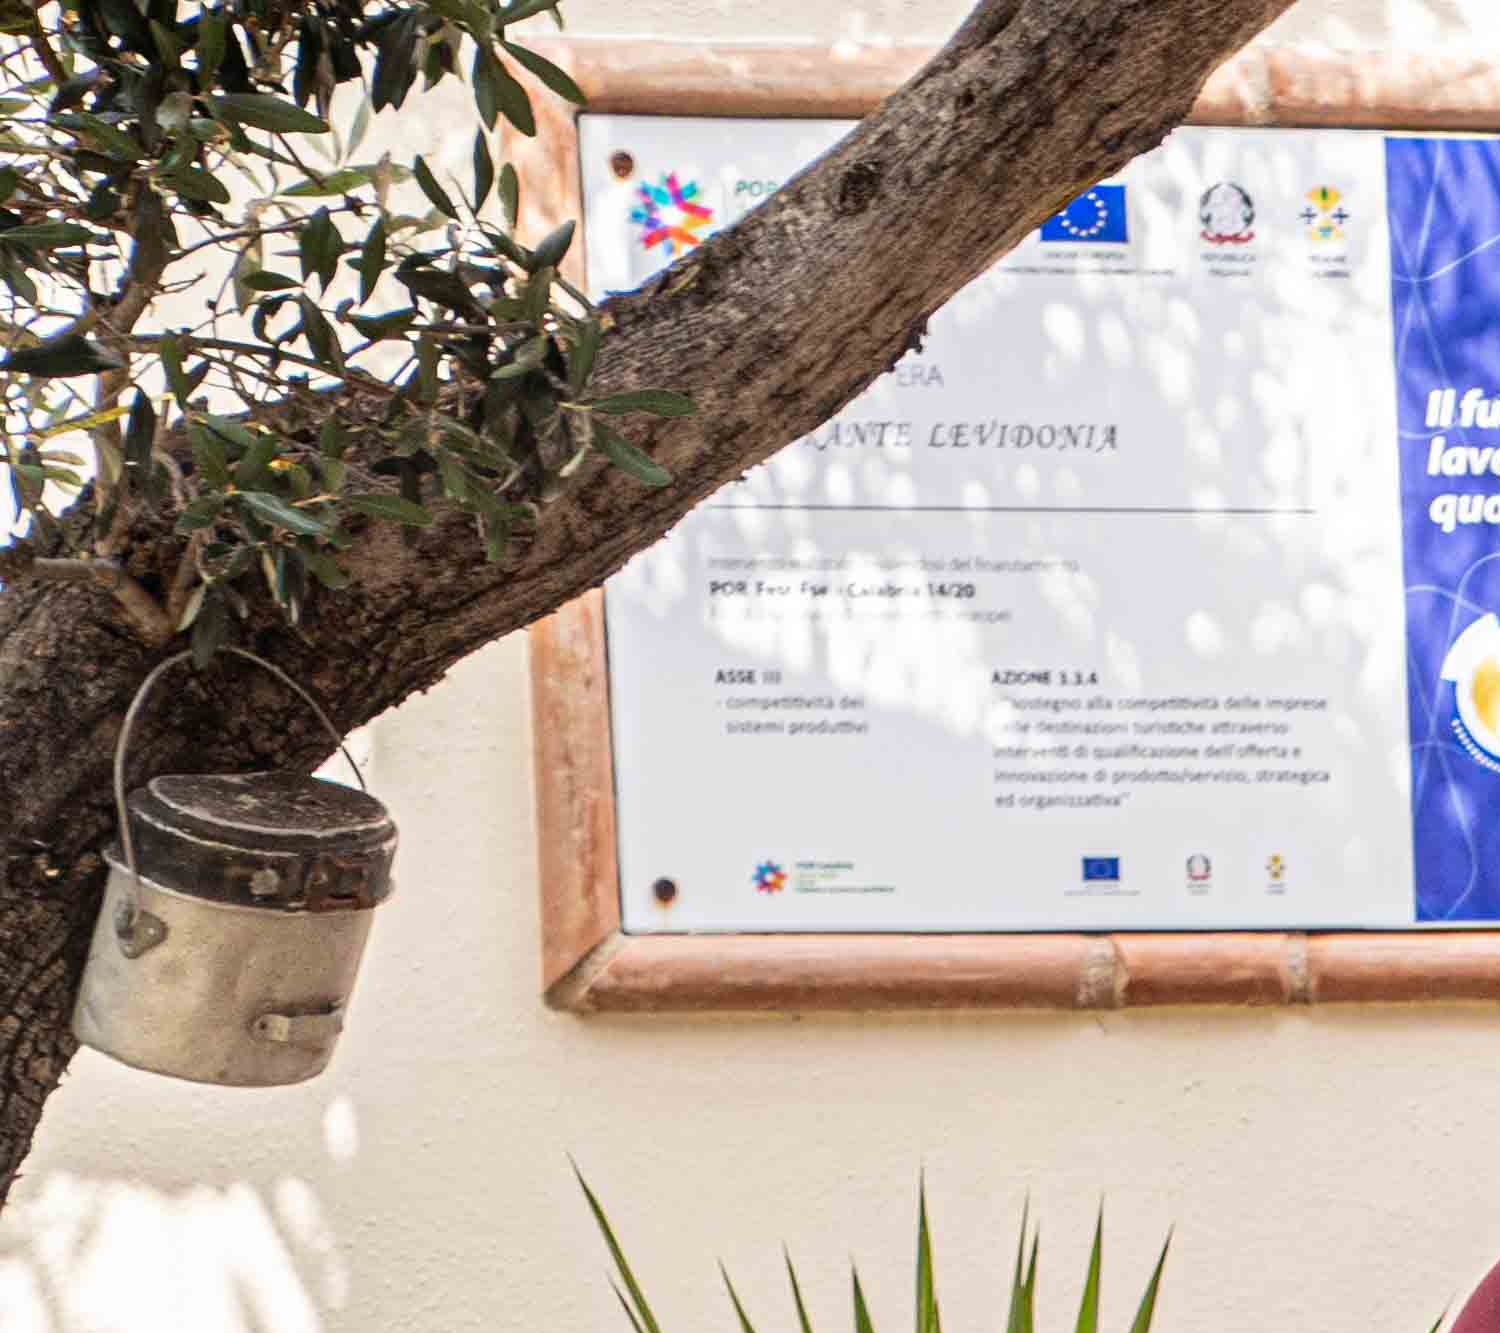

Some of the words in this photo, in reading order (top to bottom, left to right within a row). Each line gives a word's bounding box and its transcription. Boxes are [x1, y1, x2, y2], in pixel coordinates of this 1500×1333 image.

[897, 364, 945, 388] ERA
[1425, 388, 1456, 428] Il
[927, 421, 1120, 453] LEVIDONIA
[715, 669, 757, 684] ASSE
[992, 669, 1051, 685] AZIONE
